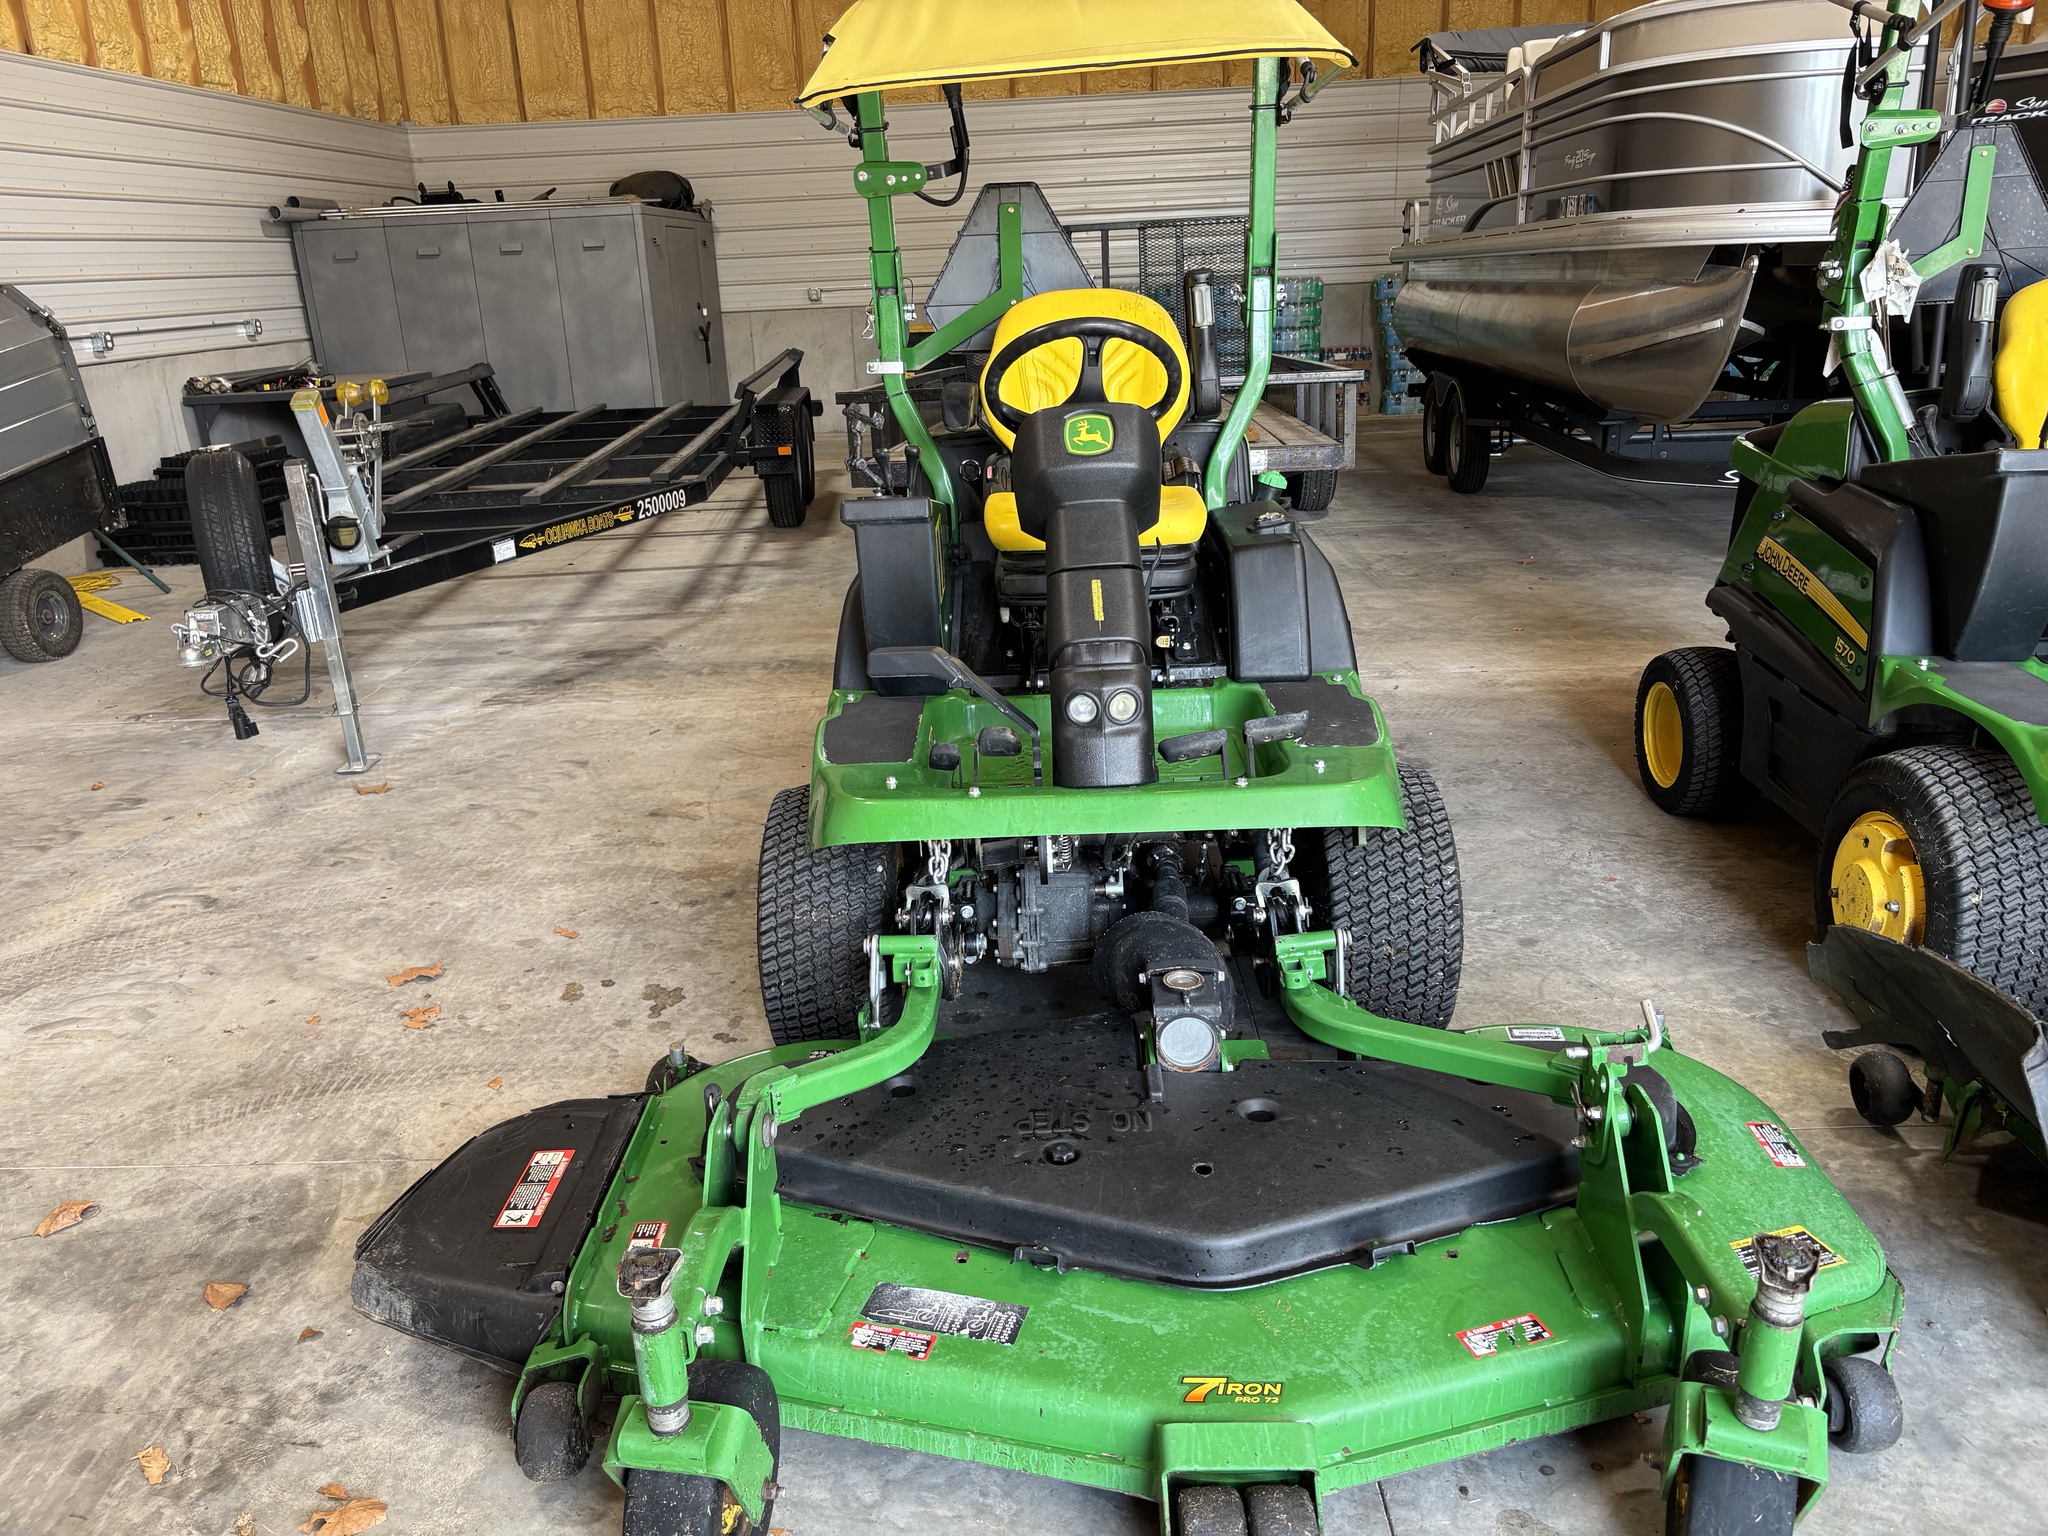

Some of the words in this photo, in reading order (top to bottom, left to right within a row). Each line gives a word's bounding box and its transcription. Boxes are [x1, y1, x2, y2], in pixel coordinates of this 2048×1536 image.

[1432, 214, 1467, 229] TRACKER
[588, 510, 615, 534] BOATS
[636, 488, 687, 520] 2500009
[1759, 541, 1783, 573] JOHN
[1782, 554, 1811, 594] DEERE
[1833, 635, 1856, 665] 1570
[1013, 1107, 1092, 1135] STEP
[1112, 1110, 1153, 1133] NO
[1234, 1396, 1261, 1404] PRO
[1264, 1396, 1279, 1404] 72
